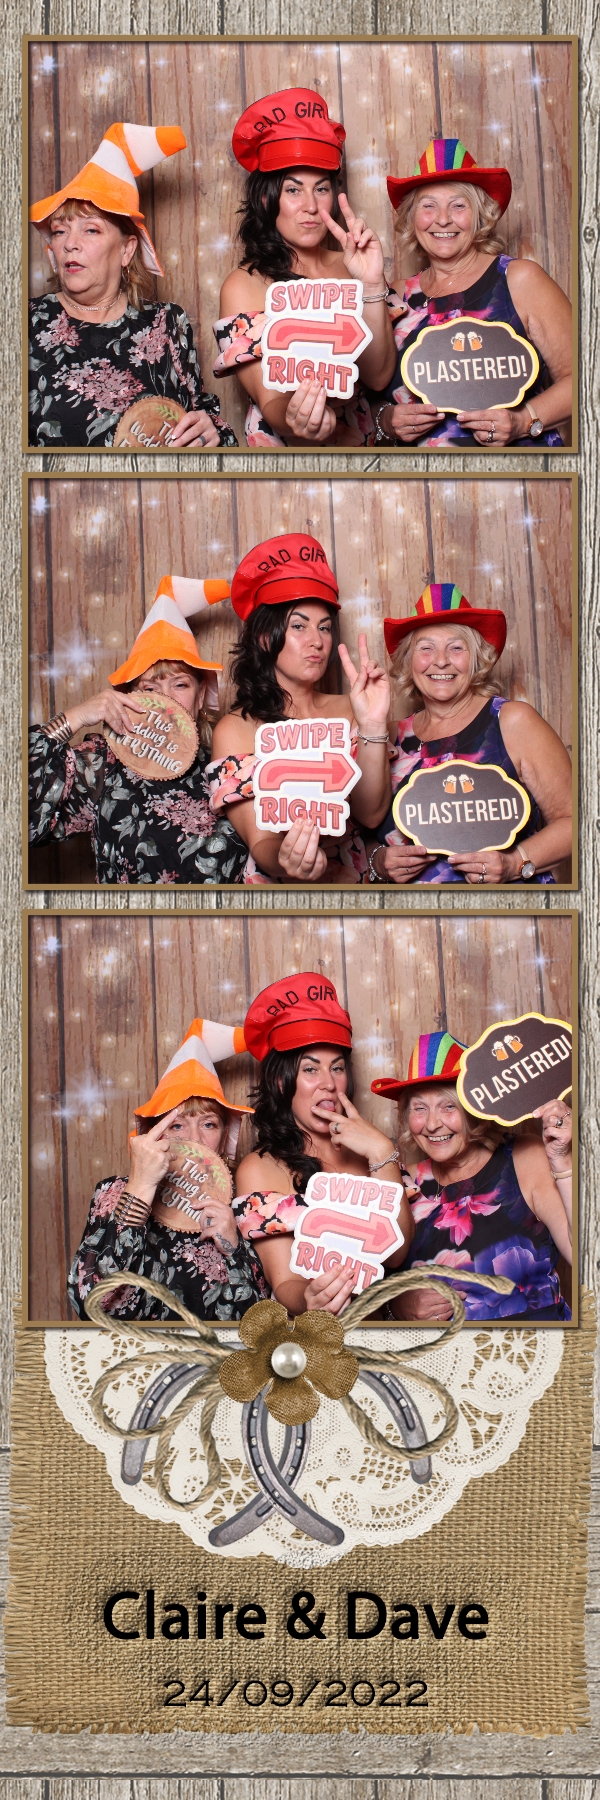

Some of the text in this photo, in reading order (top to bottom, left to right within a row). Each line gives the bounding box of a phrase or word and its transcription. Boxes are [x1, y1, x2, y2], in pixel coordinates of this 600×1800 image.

[294, 101, 325, 118] GIR
[271, 283, 358, 312] SWIPE
[267, 355, 353, 392] RIGHT
[413, 355, 528, 384] PLASTERED!
[298, 545, 326, 563] GIR
[146, 709, 174, 733] This
[132, 722, 179, 755] dding is
[260, 722, 345, 754] SWIPE
[259, 796, 344, 830] RIGHT
[405, 797, 519, 826] PLASTERED!
[307, 985, 337, 1001] GIR
[165, 1170, 200, 1198] dding
[182, 1157, 209, 1183] This
[310, 1175, 398, 1213] SWIPE
